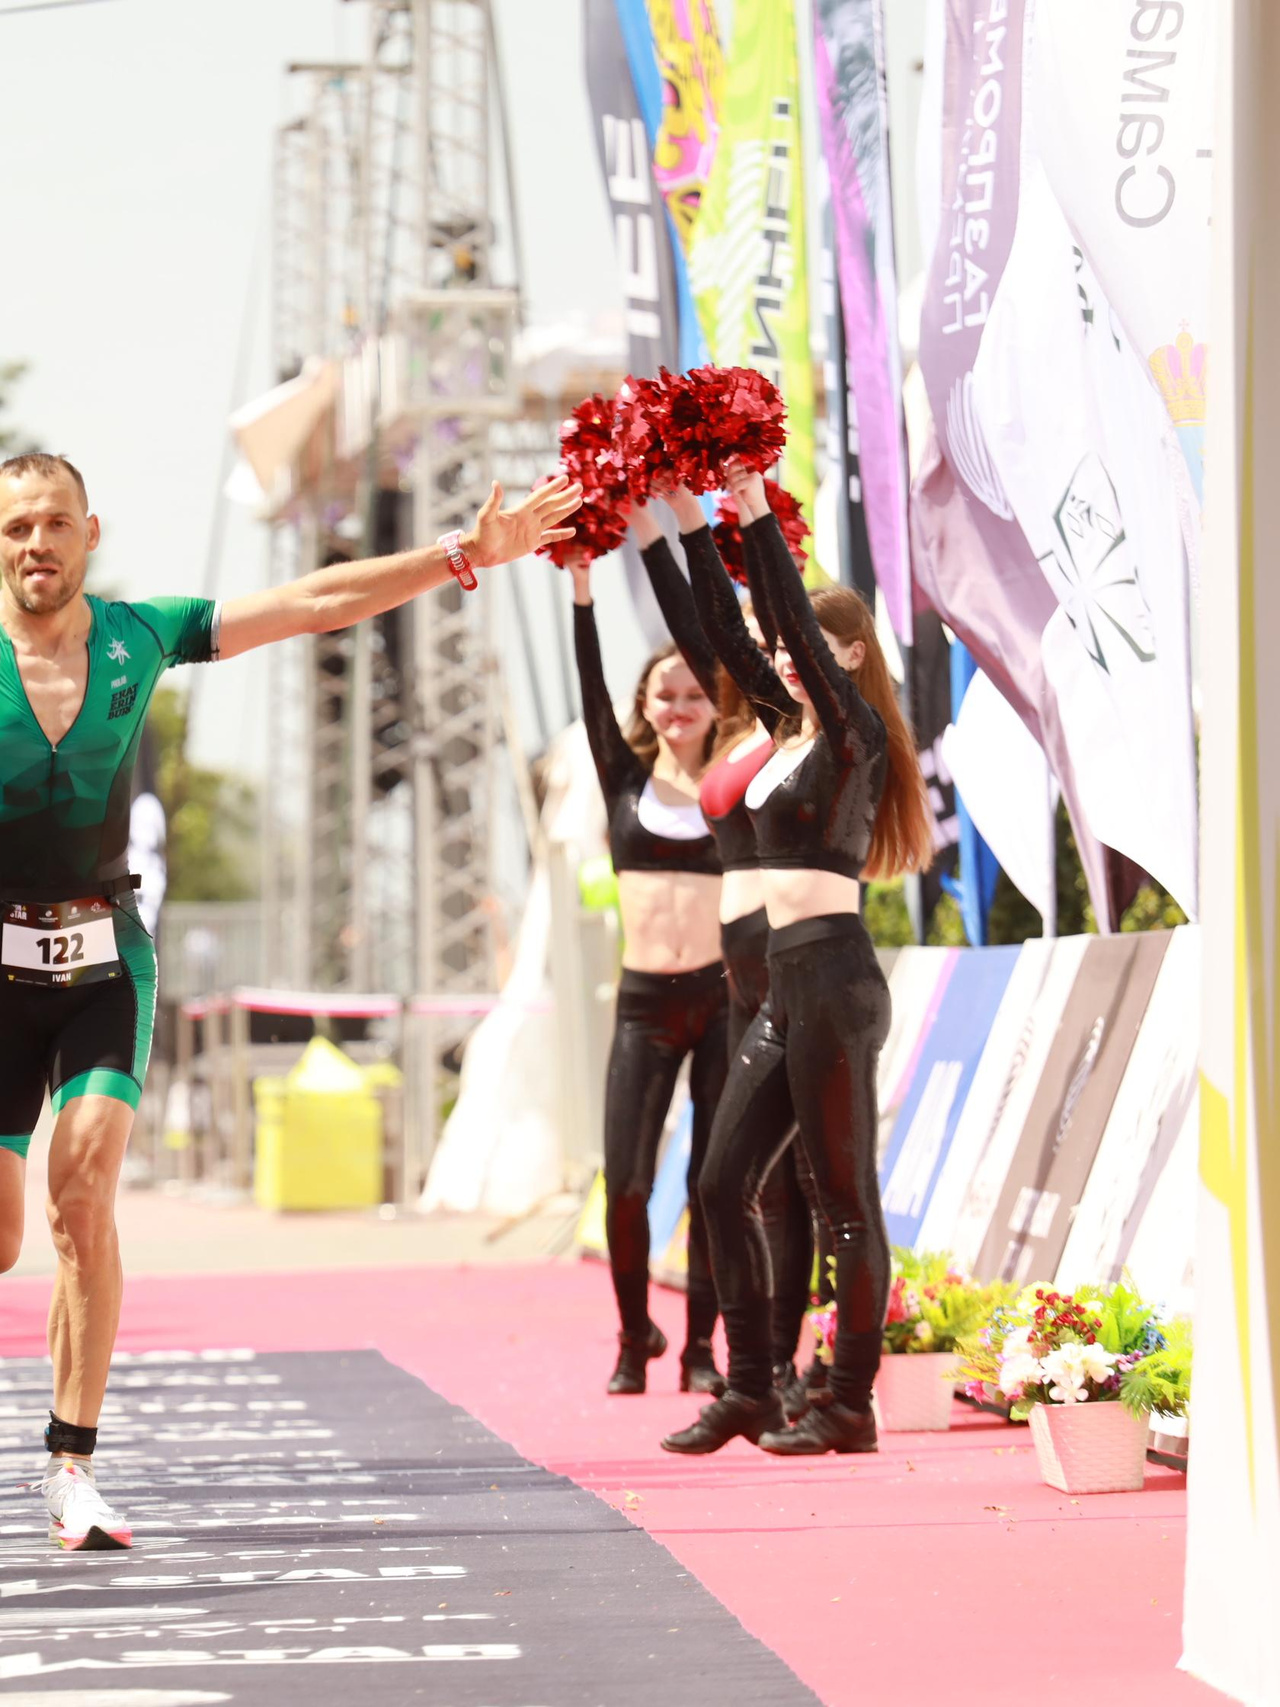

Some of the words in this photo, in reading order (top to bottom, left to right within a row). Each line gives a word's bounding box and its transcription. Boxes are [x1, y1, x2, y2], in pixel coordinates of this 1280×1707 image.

[36, 933, 84, 964] 122
[52, 973, 71, 982] IVAN
[110, 1565, 468, 1587] STAR
[120, 1643, 522, 1662] STAR
